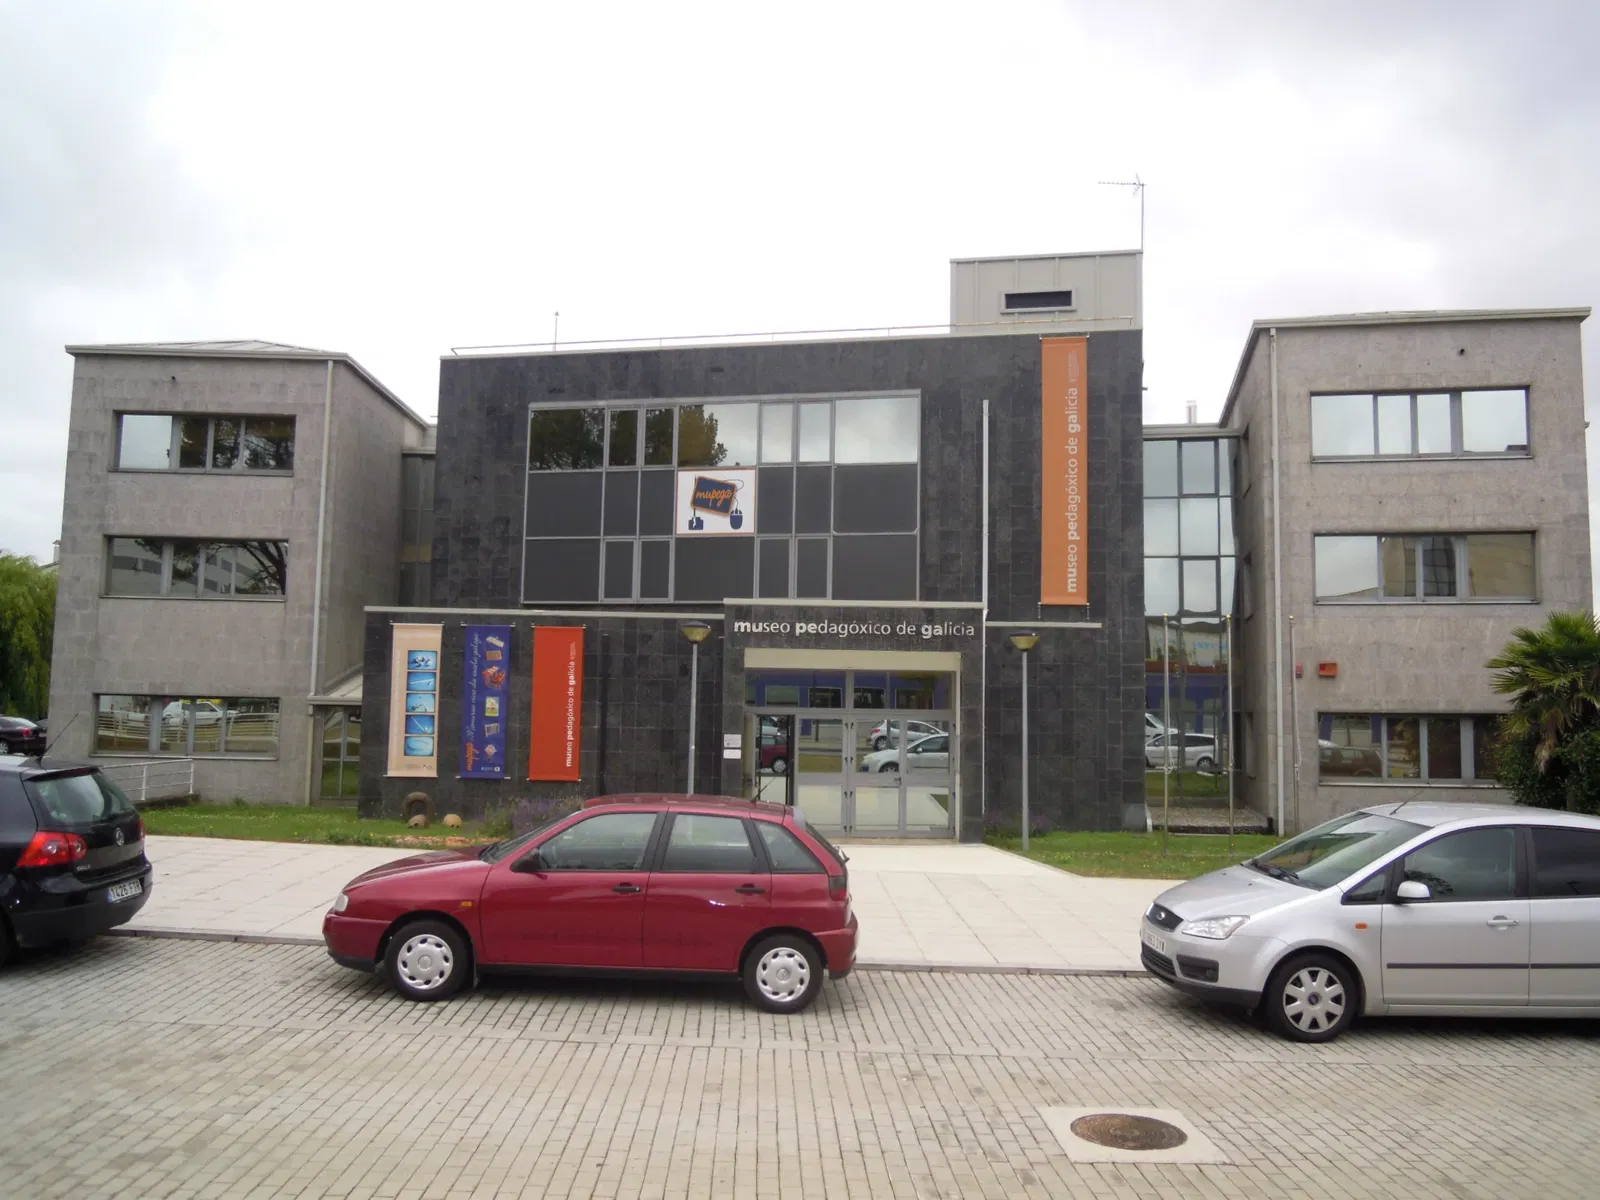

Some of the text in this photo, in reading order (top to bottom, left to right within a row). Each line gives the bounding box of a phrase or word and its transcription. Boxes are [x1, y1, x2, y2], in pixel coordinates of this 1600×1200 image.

[1065, 388, 1081, 433] galicia
[1065, 437, 1078, 454] de
[1065, 458, 1080, 540] pedagóxico
[1067, 544, 1077, 593] museo
[733, 619, 975, 639] museo pedagóxico de galicia
[567, 661, 576, 686] galicia
[566, 687, 574, 697] de
[566, 698, 575, 741] pedagóxico
